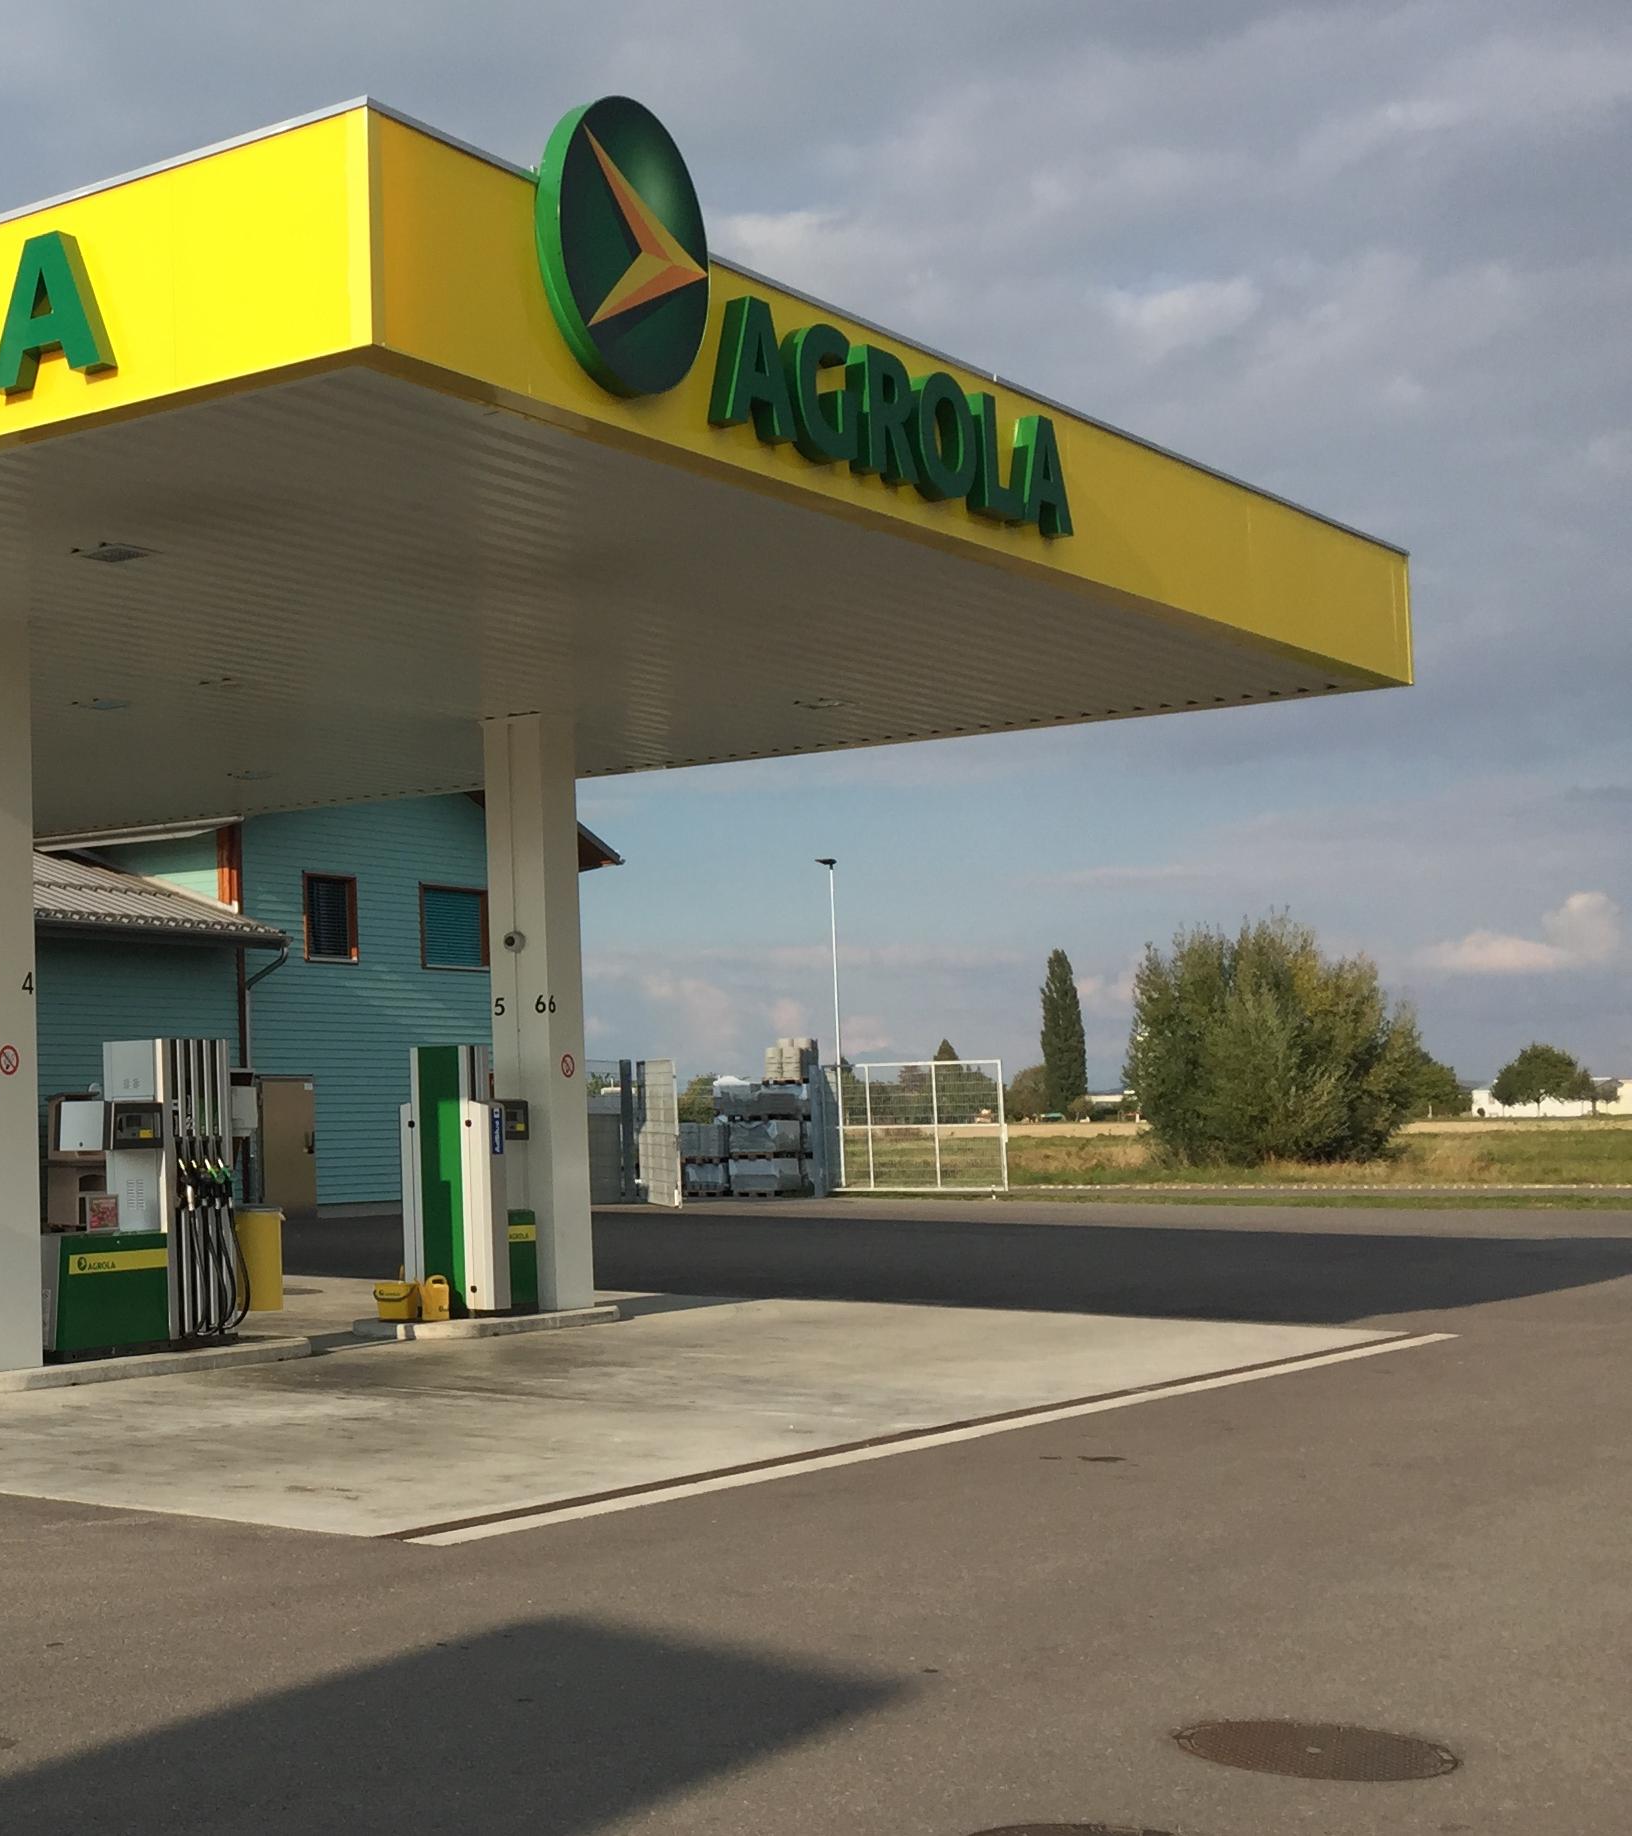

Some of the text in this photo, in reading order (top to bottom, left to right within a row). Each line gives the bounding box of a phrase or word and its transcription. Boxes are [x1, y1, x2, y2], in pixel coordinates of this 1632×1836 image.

[707, 295, 1074, 539] AGROLA
[22, 971, 34, 995] 4
[494, 997, 505, 1016] 5
[88, 1261, 117, 1270] AGROLA
